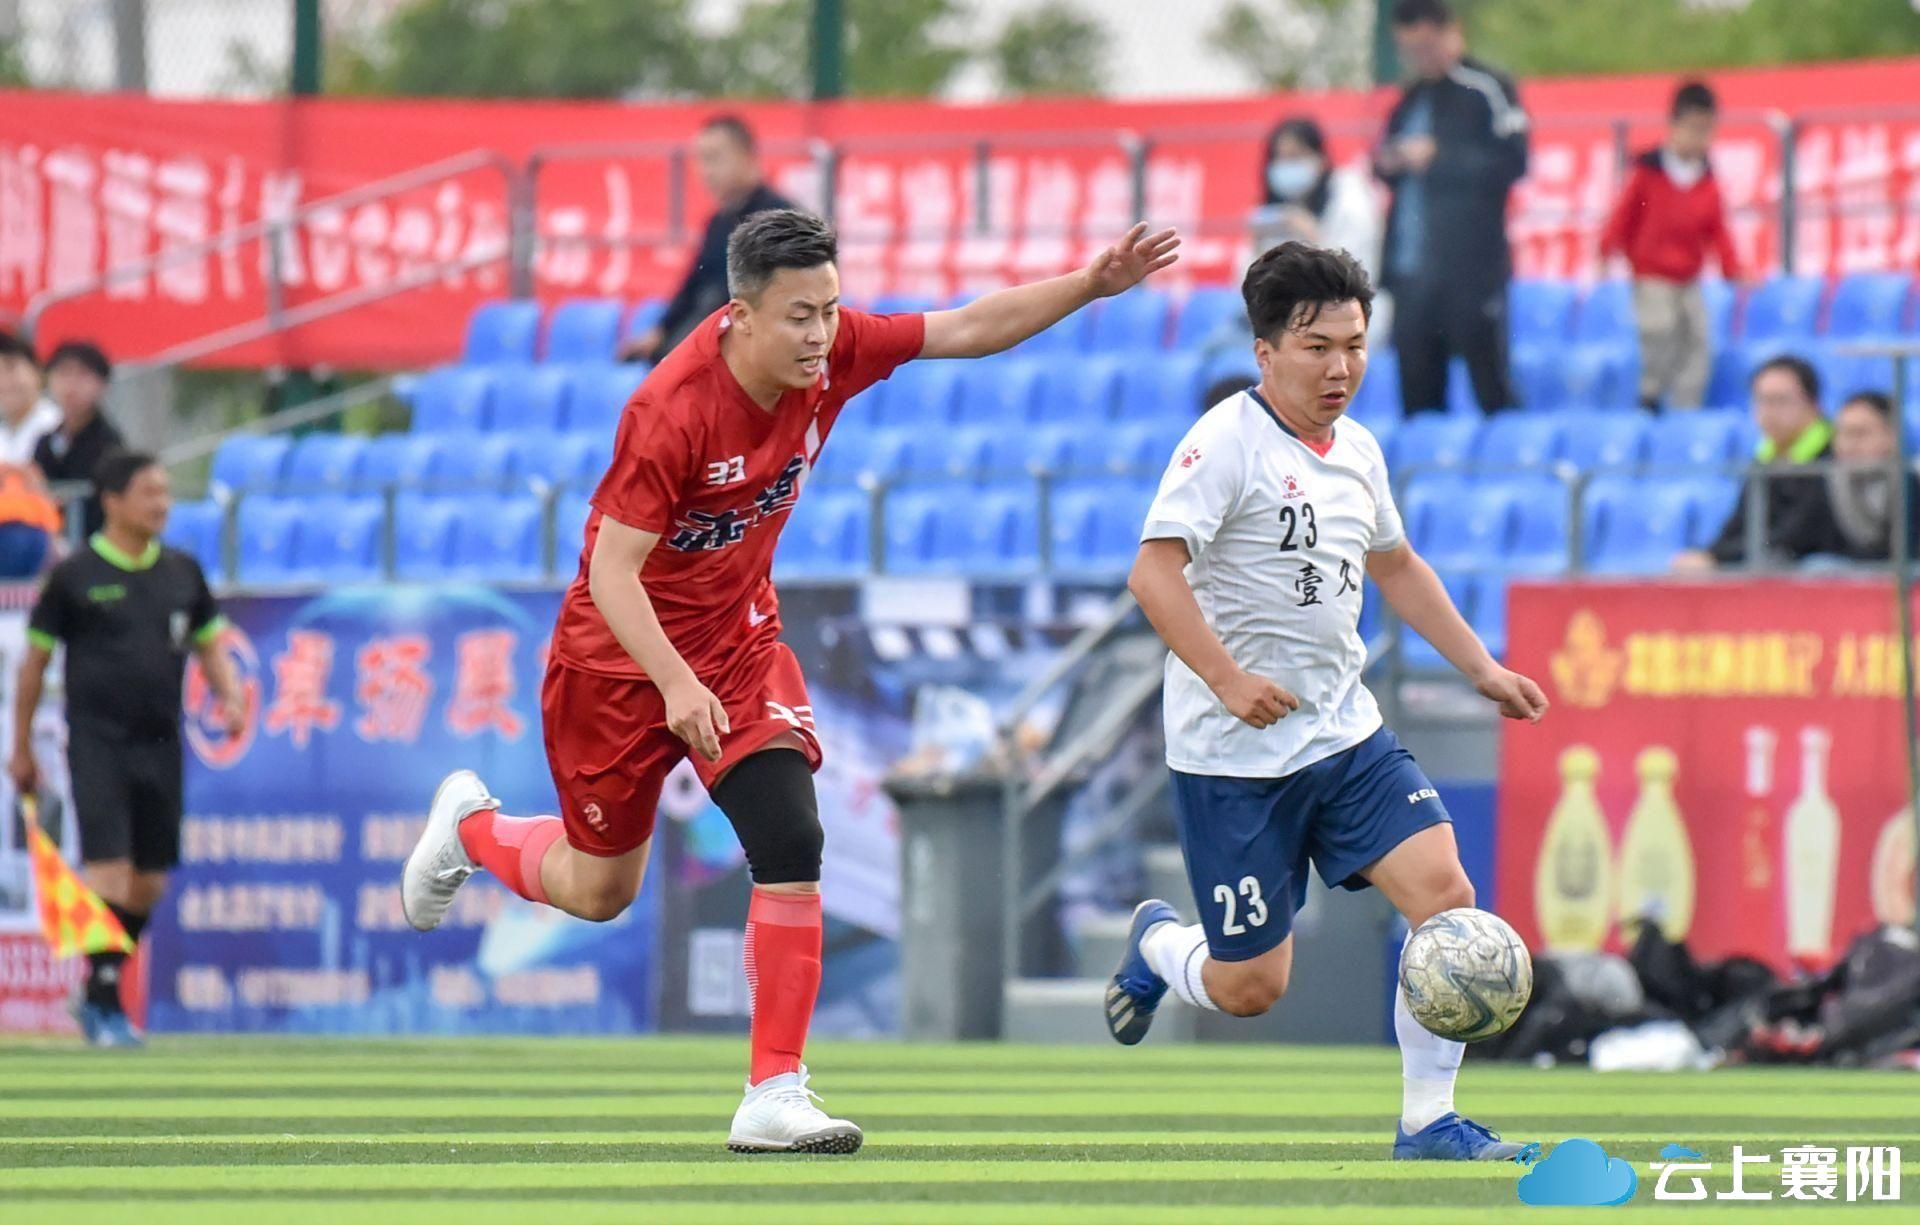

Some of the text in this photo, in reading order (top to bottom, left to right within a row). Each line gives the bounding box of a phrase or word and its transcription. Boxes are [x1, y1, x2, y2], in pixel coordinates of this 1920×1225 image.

[706, 455, 746, 485] 33
[1279, 502, 1317, 552] 23
[1213, 875, 1268, 936] 23
